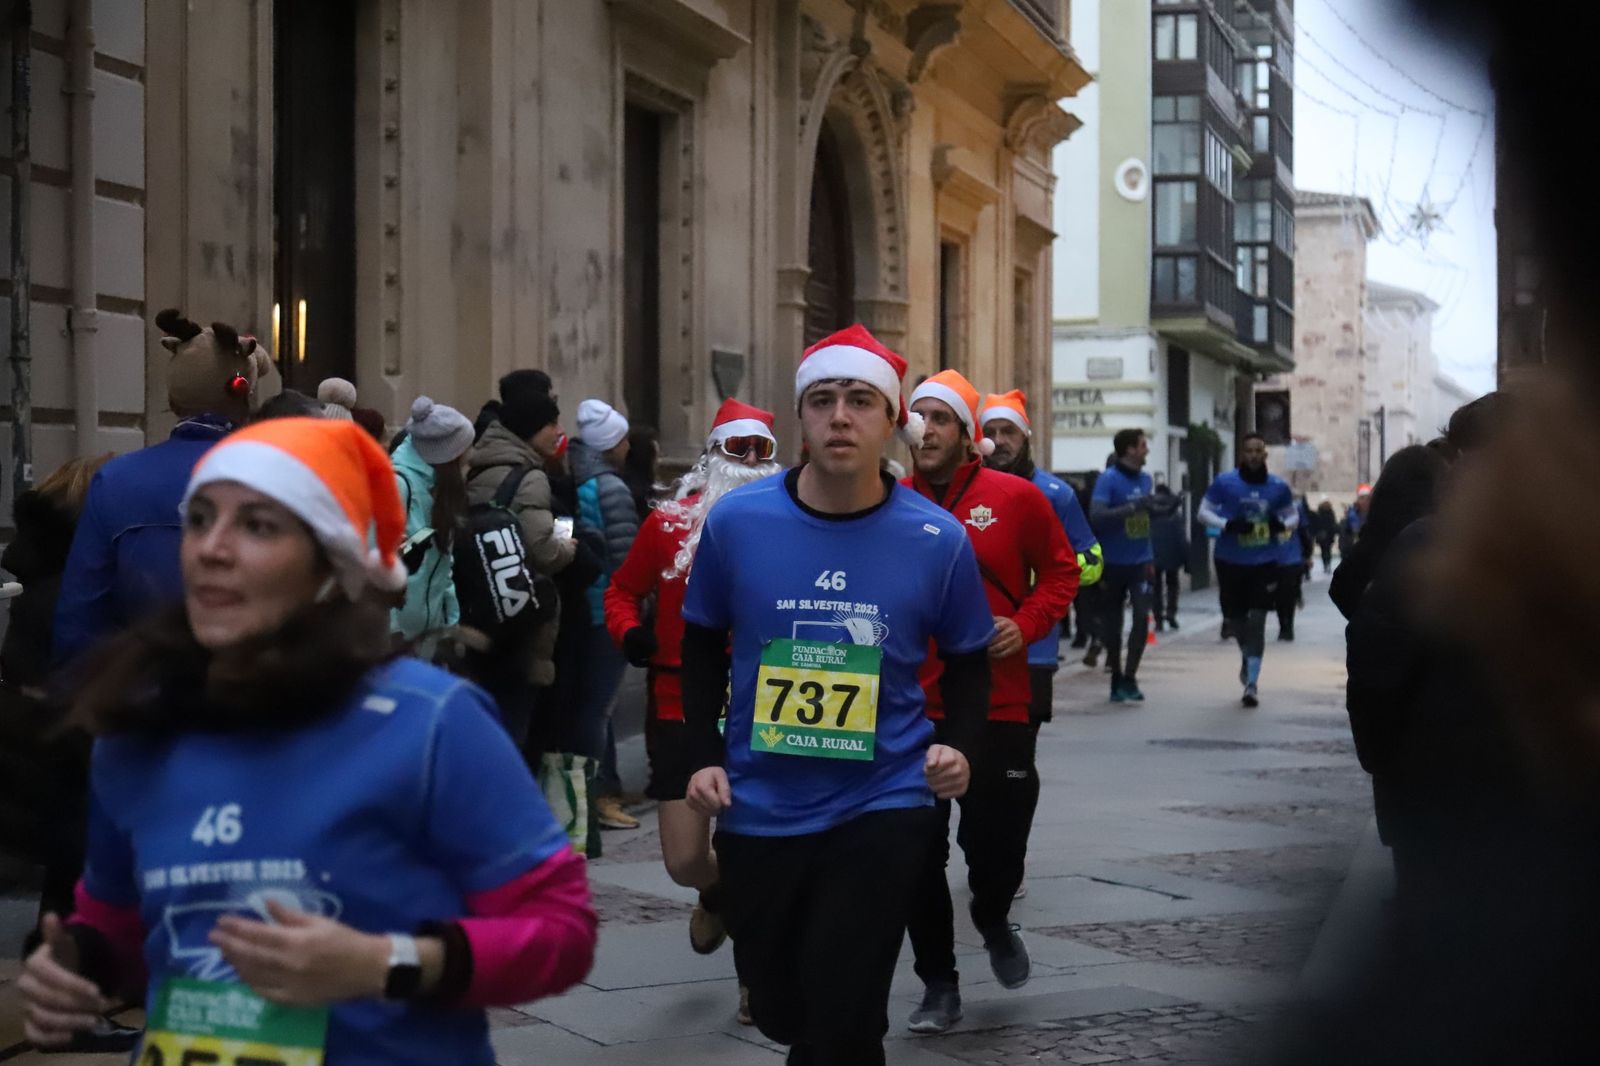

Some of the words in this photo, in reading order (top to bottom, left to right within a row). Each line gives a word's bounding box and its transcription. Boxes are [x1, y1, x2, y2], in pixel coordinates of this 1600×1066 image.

[483, 528, 530, 617] FILA
[815, 570, 847, 591] 46
[776, 599, 796, 610] SAN
[798, 600, 852, 612] SILVESTRE
[854, 602, 879, 615] 2025
[792, 653, 813, 662] CAJA
[816, 655, 846, 665] RURAL
[765, 678, 860, 727] 737
[786, 734, 818, 749] CAJA
[821, 737, 867, 751] RURAL
[191, 803, 243, 847] 46
